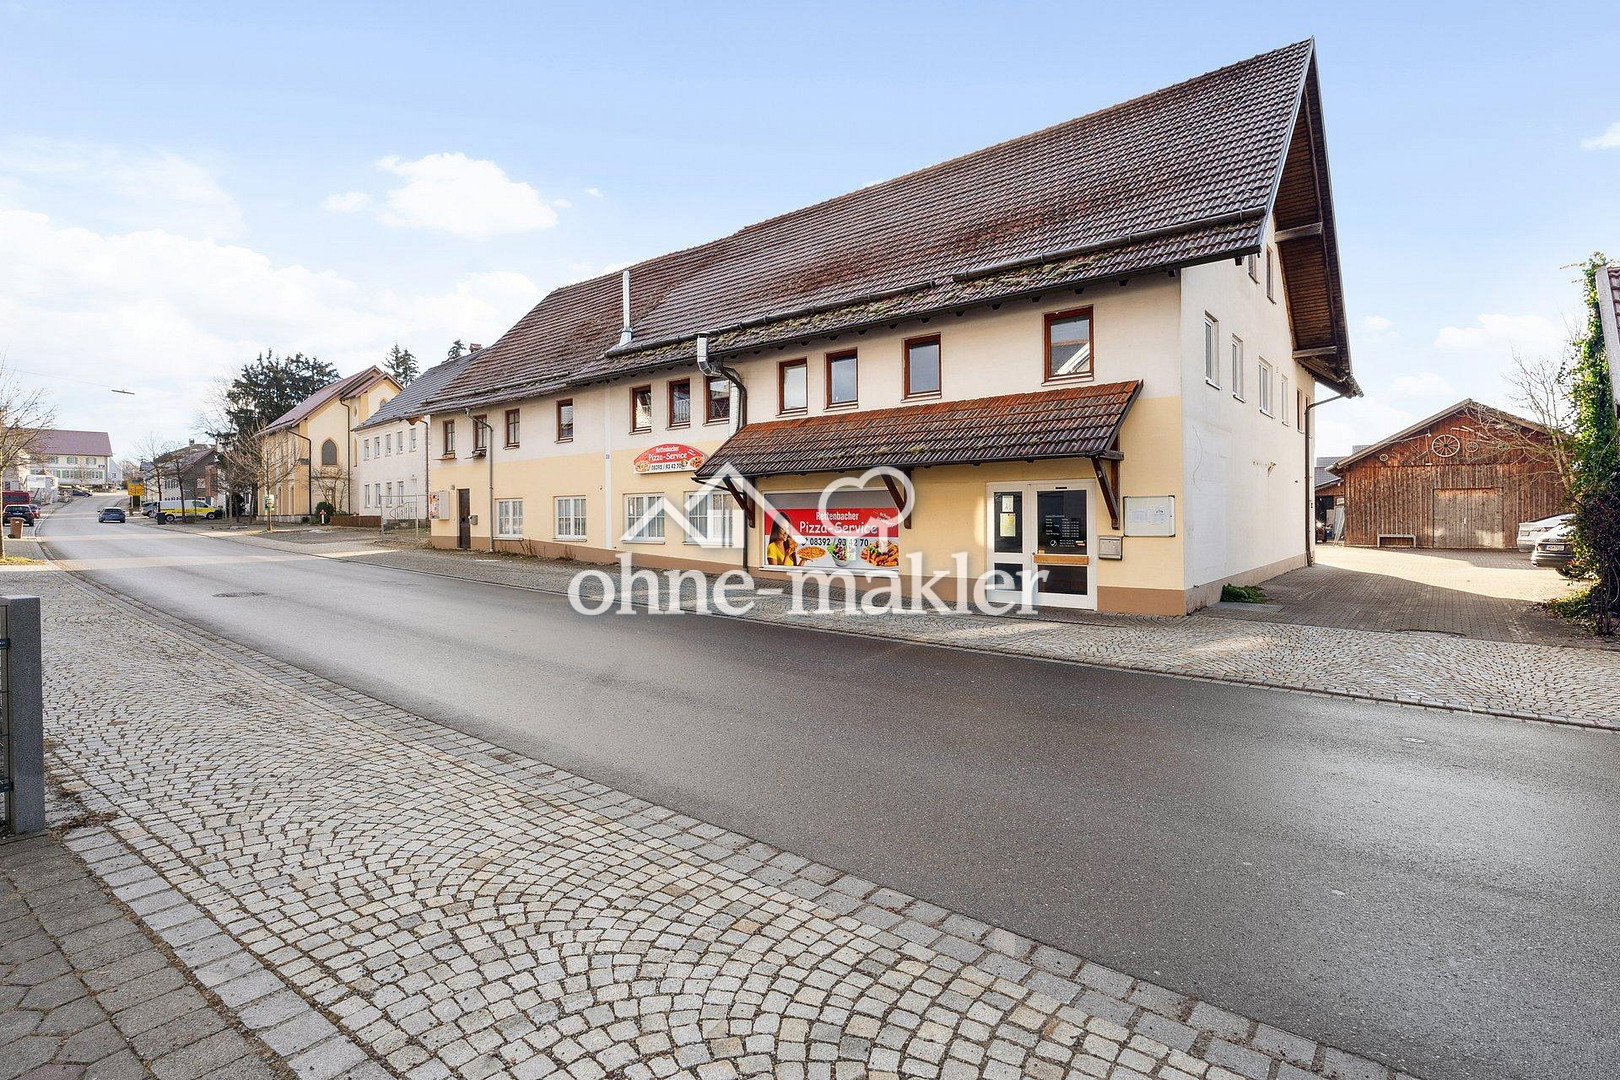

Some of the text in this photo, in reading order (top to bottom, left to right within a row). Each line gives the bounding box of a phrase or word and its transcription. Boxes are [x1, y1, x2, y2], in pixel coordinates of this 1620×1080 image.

[799, 521, 878, 534] Pizza-Service
[809, 537, 831, 546] 08392
[860, 538, 869, 547] 70
